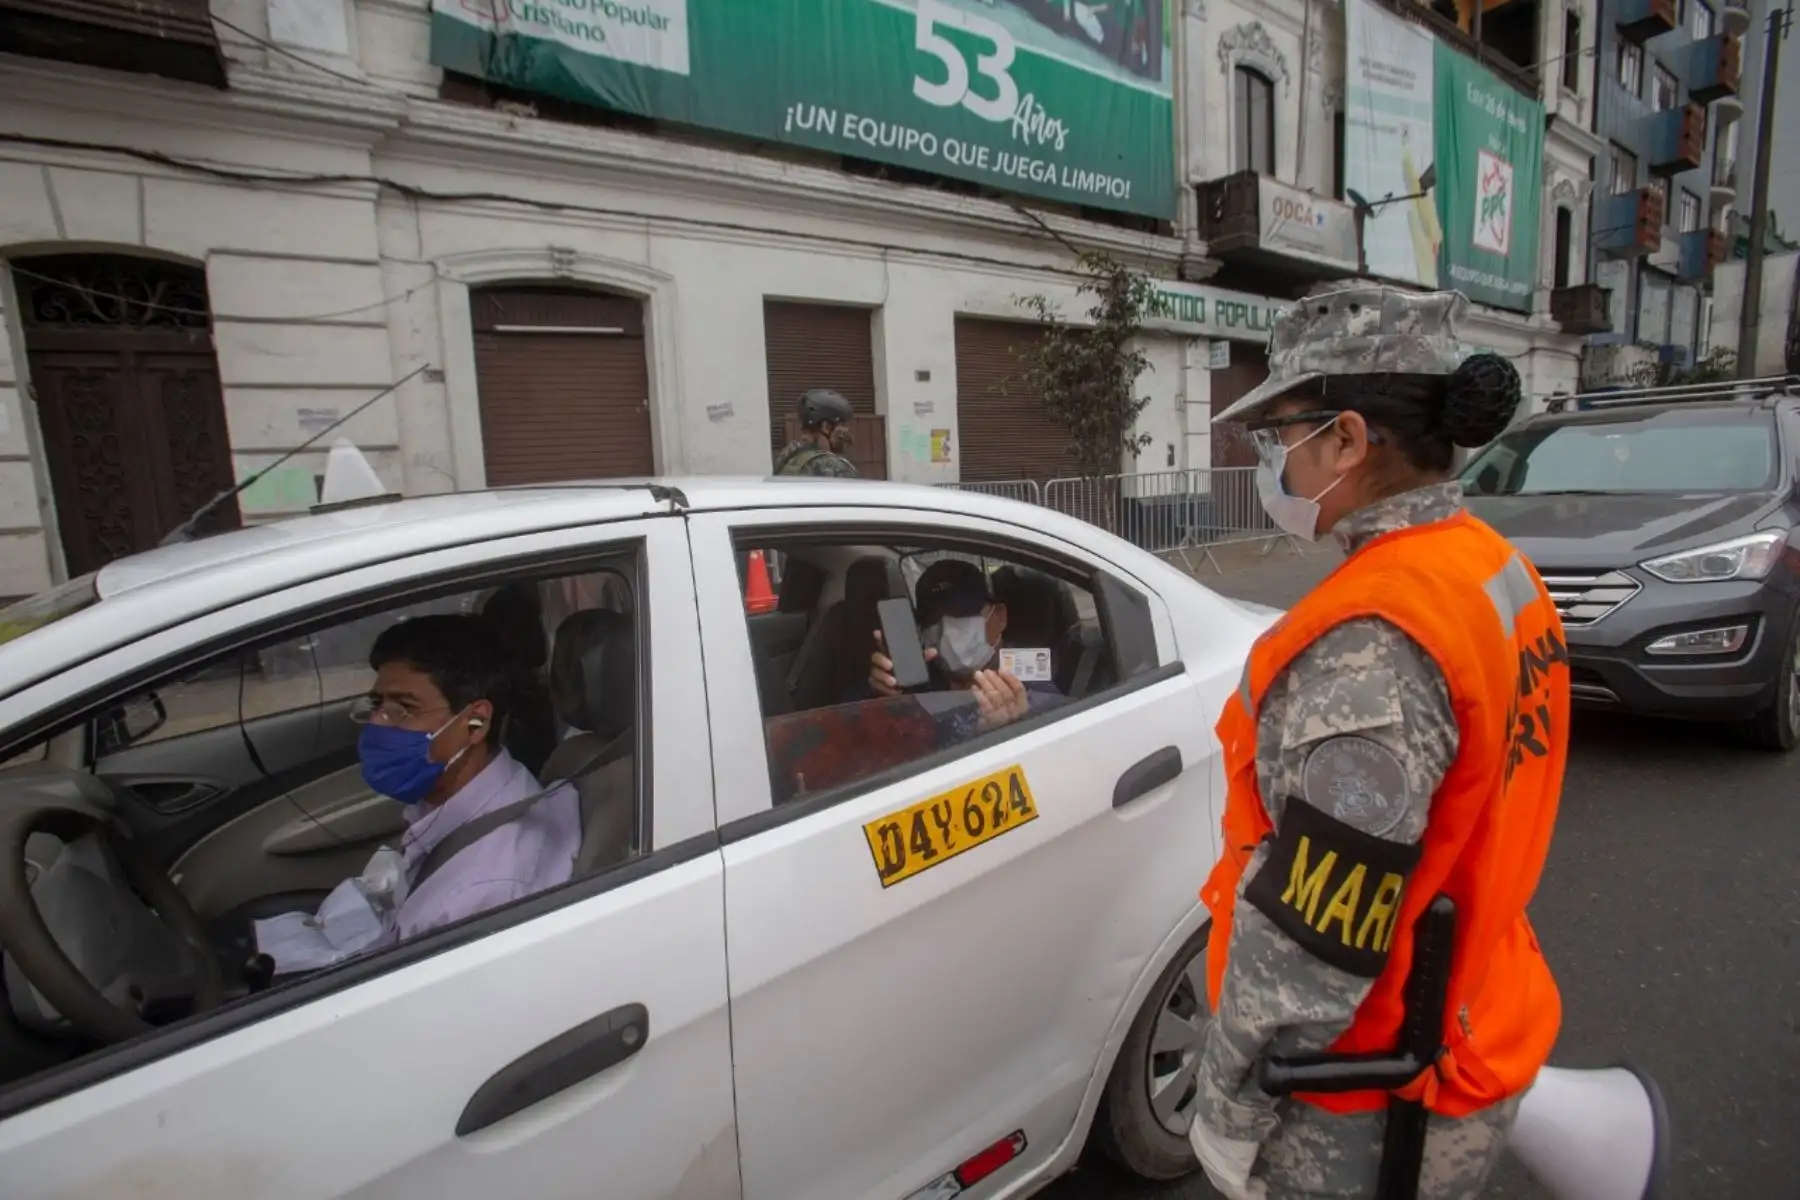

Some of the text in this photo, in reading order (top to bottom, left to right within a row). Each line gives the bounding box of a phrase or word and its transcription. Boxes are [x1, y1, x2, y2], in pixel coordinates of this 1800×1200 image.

[912, 0, 1070, 150] 53 Años
[784, 102, 1131, 199] ¡UN EQUIPO QUE JUEGA LIMPIO!
[1272, 196, 1313, 228] ODCA
